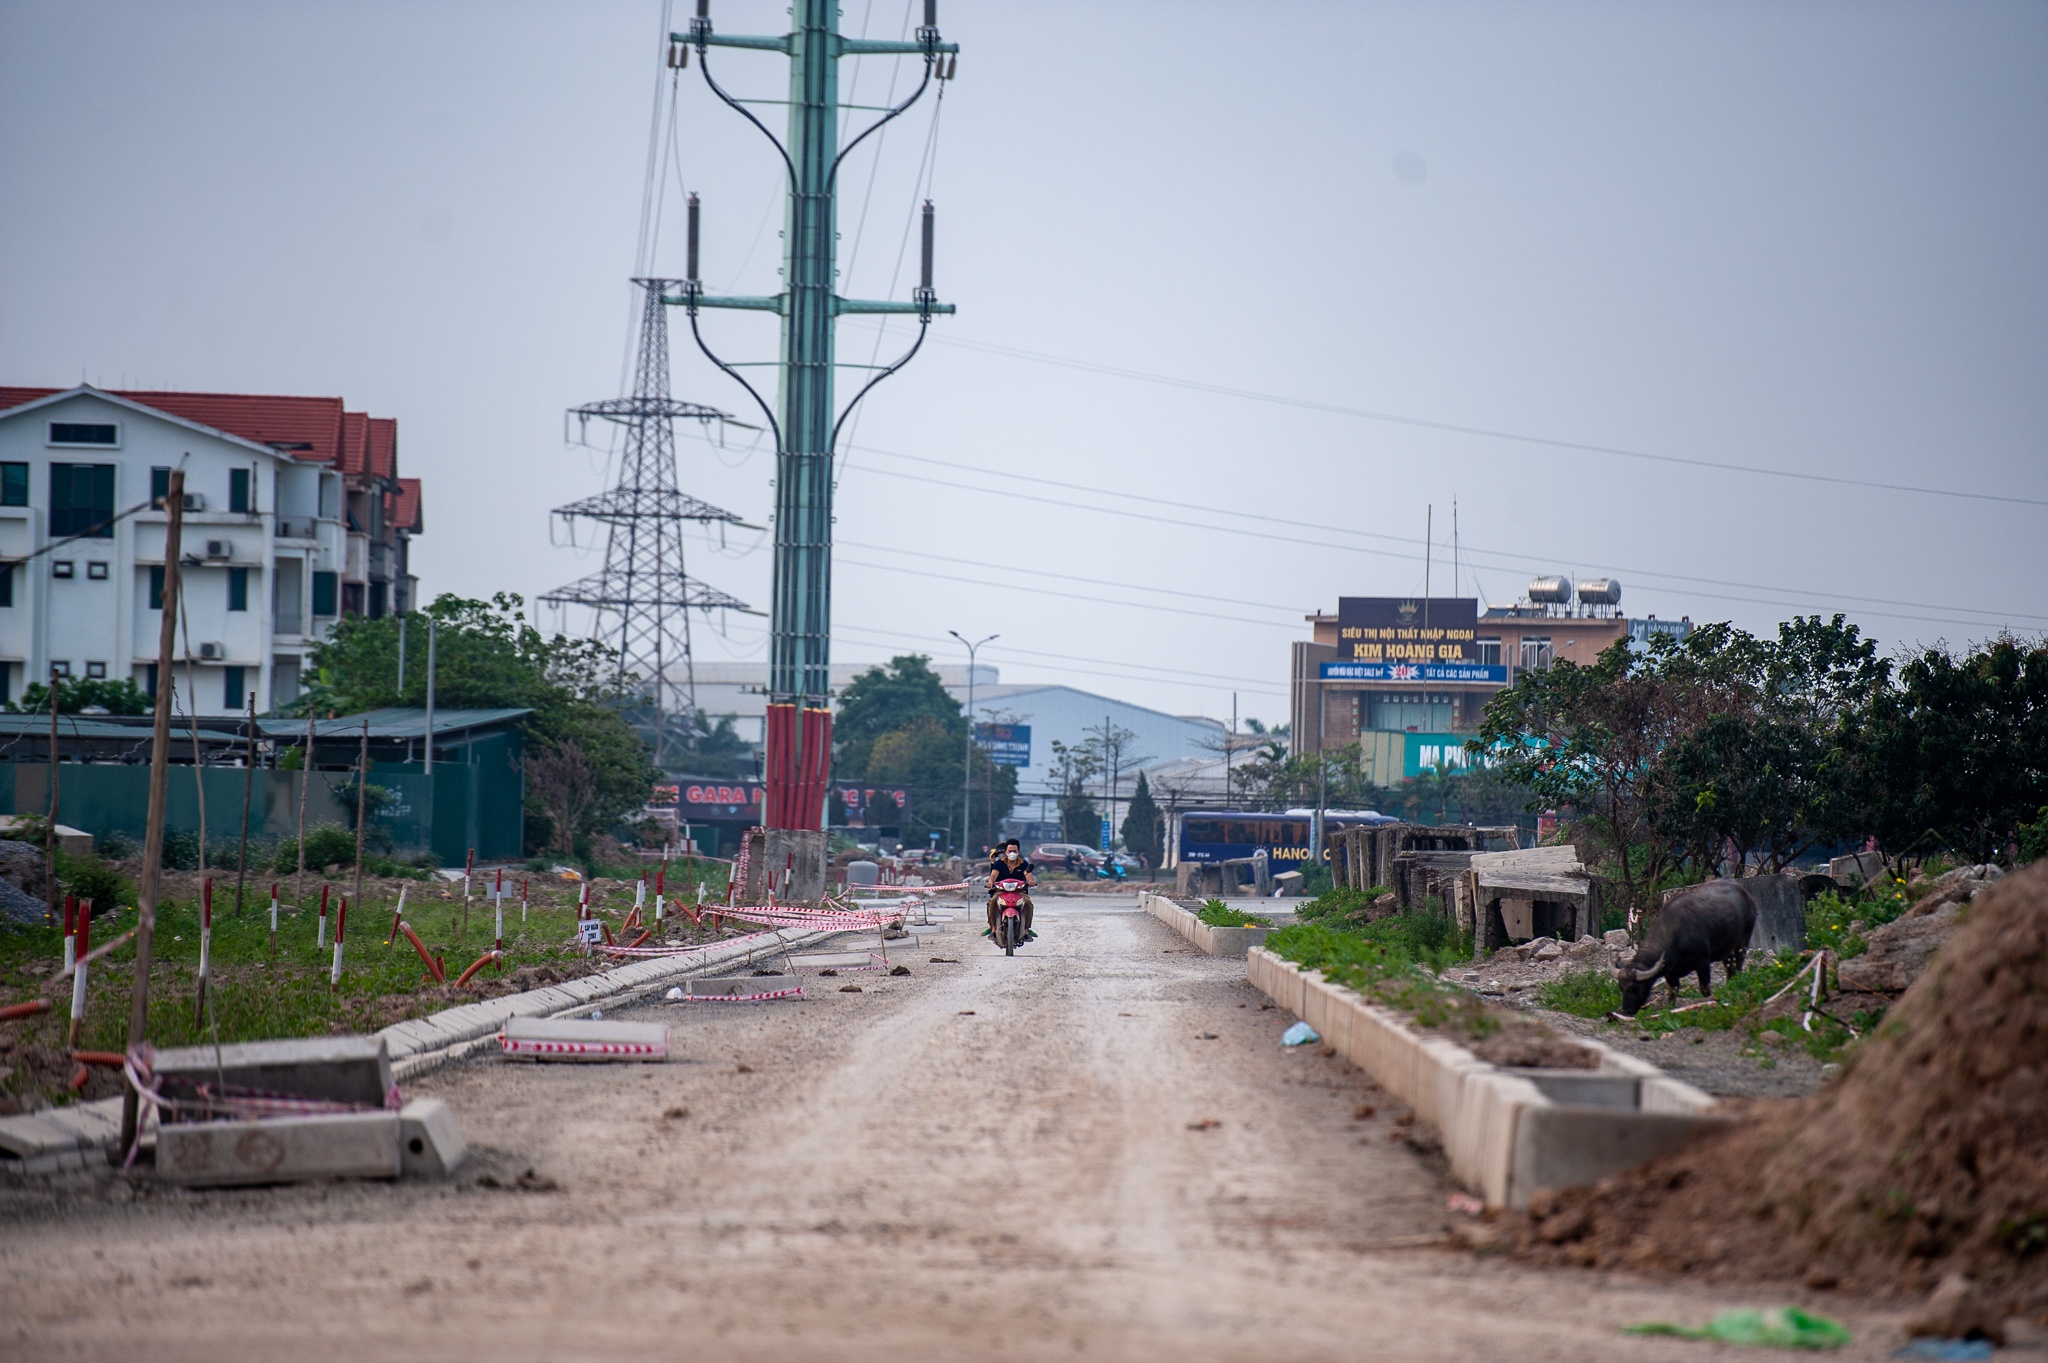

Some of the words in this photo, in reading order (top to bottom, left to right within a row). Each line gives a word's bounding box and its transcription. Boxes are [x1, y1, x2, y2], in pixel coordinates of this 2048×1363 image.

[1342, 626, 1361, 639] SIÊU
[1364, 628, 1378, 641] THỊ
[1380, 627, 1395, 641] NỘI
[1397, 626, 1418, 640] THẤT
[1420, 627, 1444, 641] NHẬP
[1447, 629, 1474, 642] NGOẠI
[1354, 643, 1382, 657] KIM
[1386, 641, 1434, 659] HOÀNG
[1438, 645, 1463, 659] GIA
[686, 785, 747, 804] GARA
